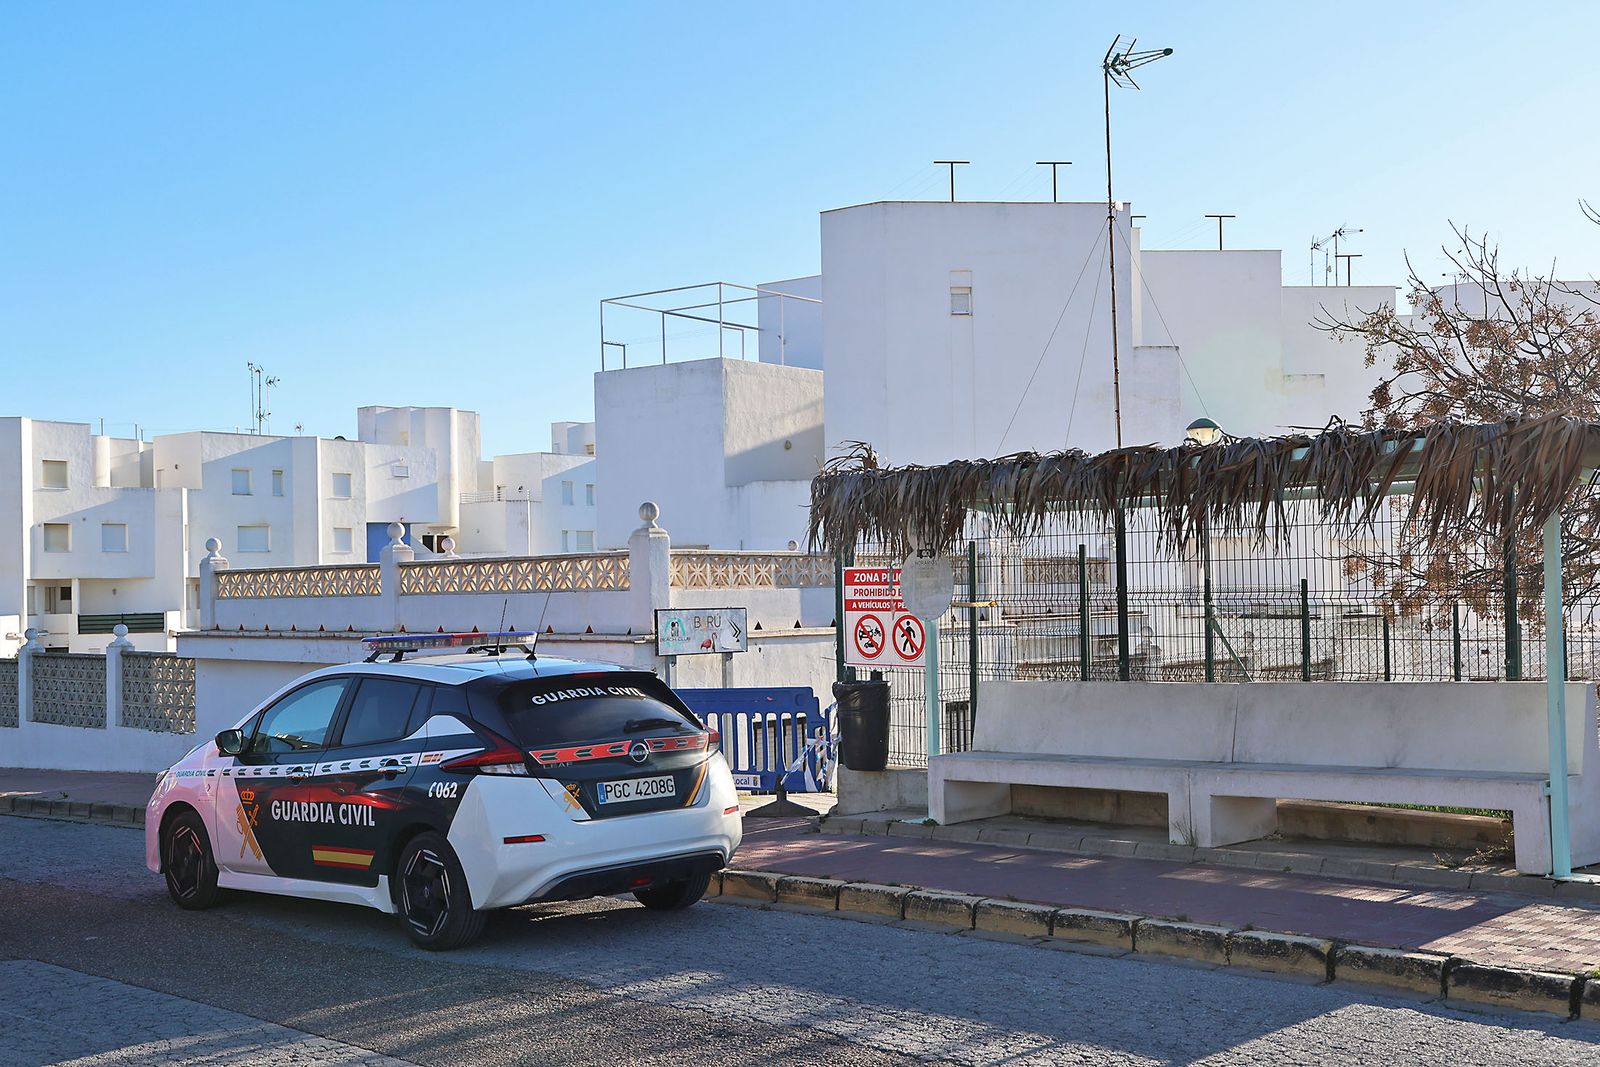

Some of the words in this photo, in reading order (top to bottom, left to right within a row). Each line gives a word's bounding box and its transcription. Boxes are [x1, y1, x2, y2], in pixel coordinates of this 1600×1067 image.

[854, 573, 879, 582] ZONA
[853, 588, 896, 597] PROHIBIDO
[858, 600, 890, 608] VEHÍCULOS
[531, 687, 607, 705] GUARDIA
[607, 686, 646, 697] CIVIL
[543, 761, 574, 770] LEAF
[734, 776, 750, 785] ocal
[435, 782, 458, 799] 062
[605, 783, 630, 800] PGC
[635, 779, 674, 797] 4208G
[271, 800, 335, 824] GUARDIA
[338, 804, 376, 827] CIVIL
